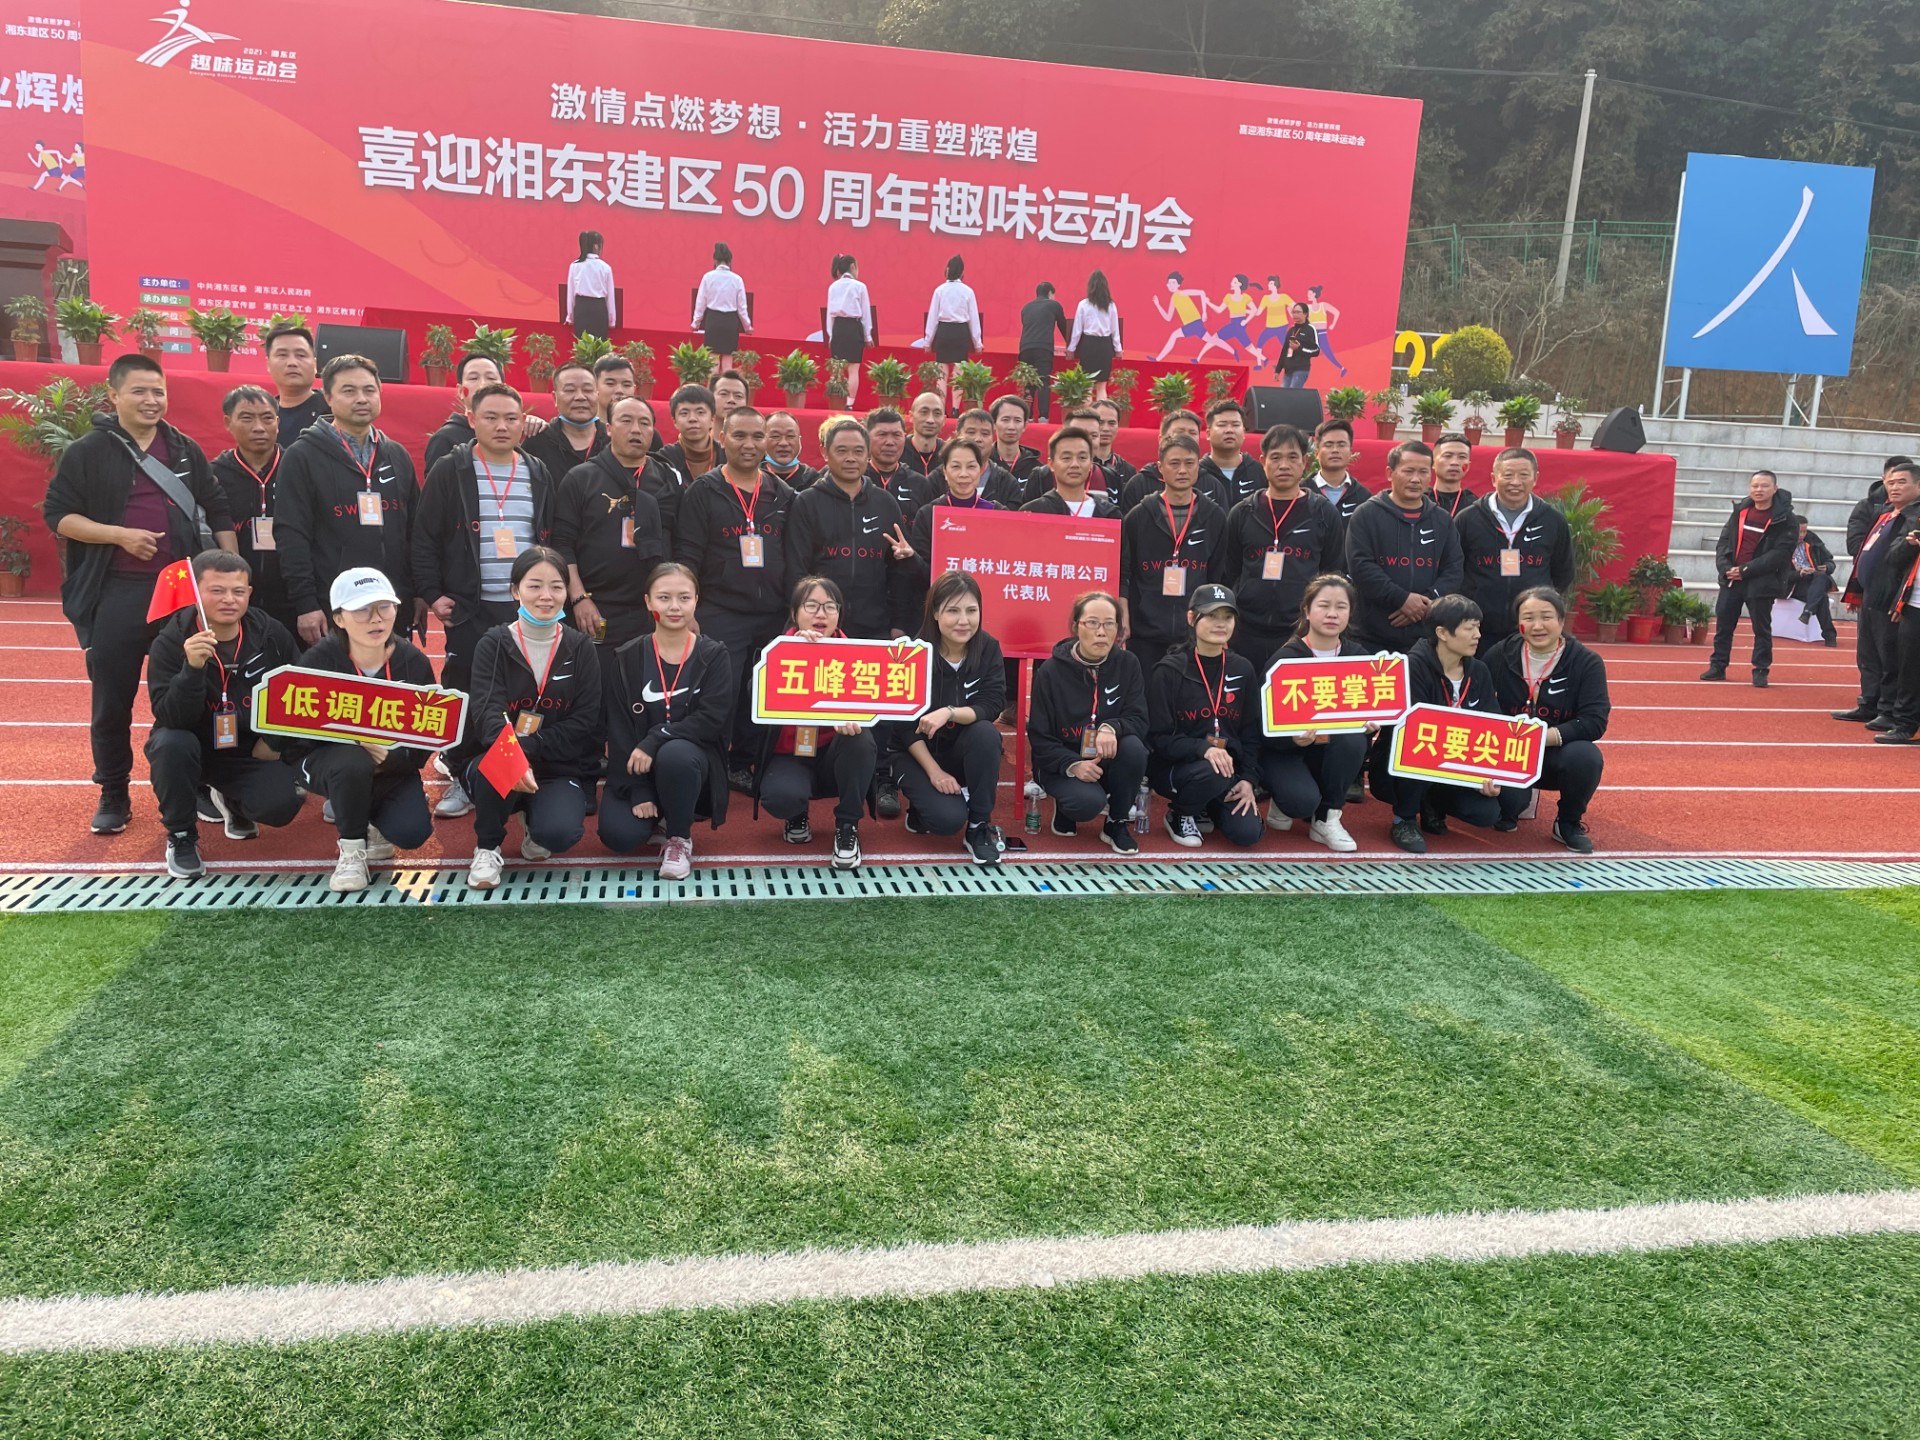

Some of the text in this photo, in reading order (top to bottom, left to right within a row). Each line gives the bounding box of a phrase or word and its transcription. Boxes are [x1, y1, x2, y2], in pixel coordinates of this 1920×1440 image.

[190, 53, 298, 79] 趣味运动会
[945, 556, 1108, 582] 五峰林业发展有限公司
[1003, 584, 1050, 602] 代表队
[1213, 586, 1225, 599] LA
[776, 658, 917, 701] 五峰驾到
[1281, 672, 1397, 712] 不要掌声
[280, 683, 448, 736] 低调低调
[1411, 722, 1532, 771] 只要尖叫
